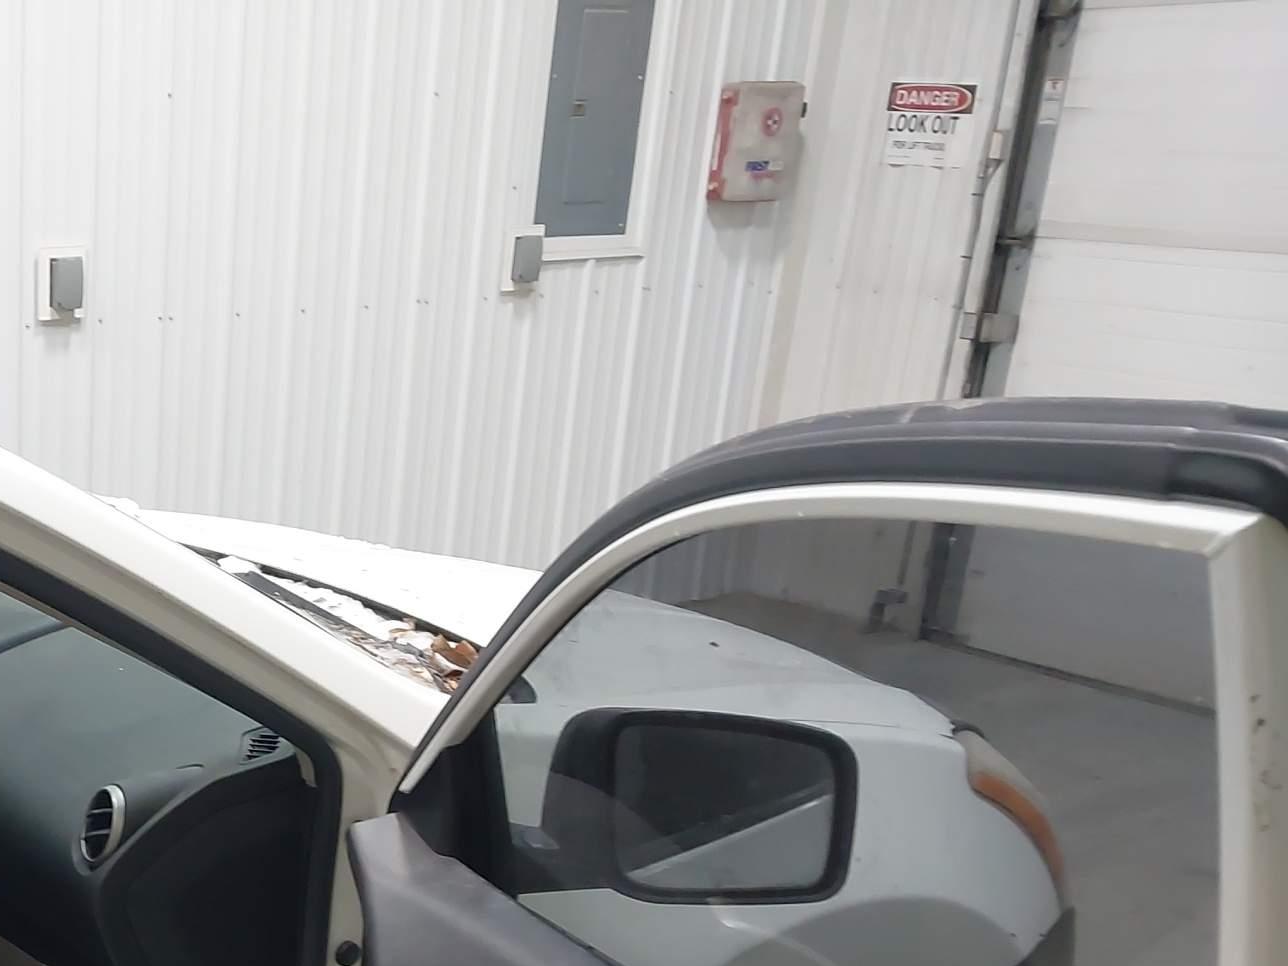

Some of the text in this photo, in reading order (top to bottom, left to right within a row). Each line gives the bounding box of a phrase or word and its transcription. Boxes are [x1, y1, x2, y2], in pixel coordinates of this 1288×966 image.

[895, 91, 960, 106] DANGER
[887, 113, 960, 134] LOOK OUT
